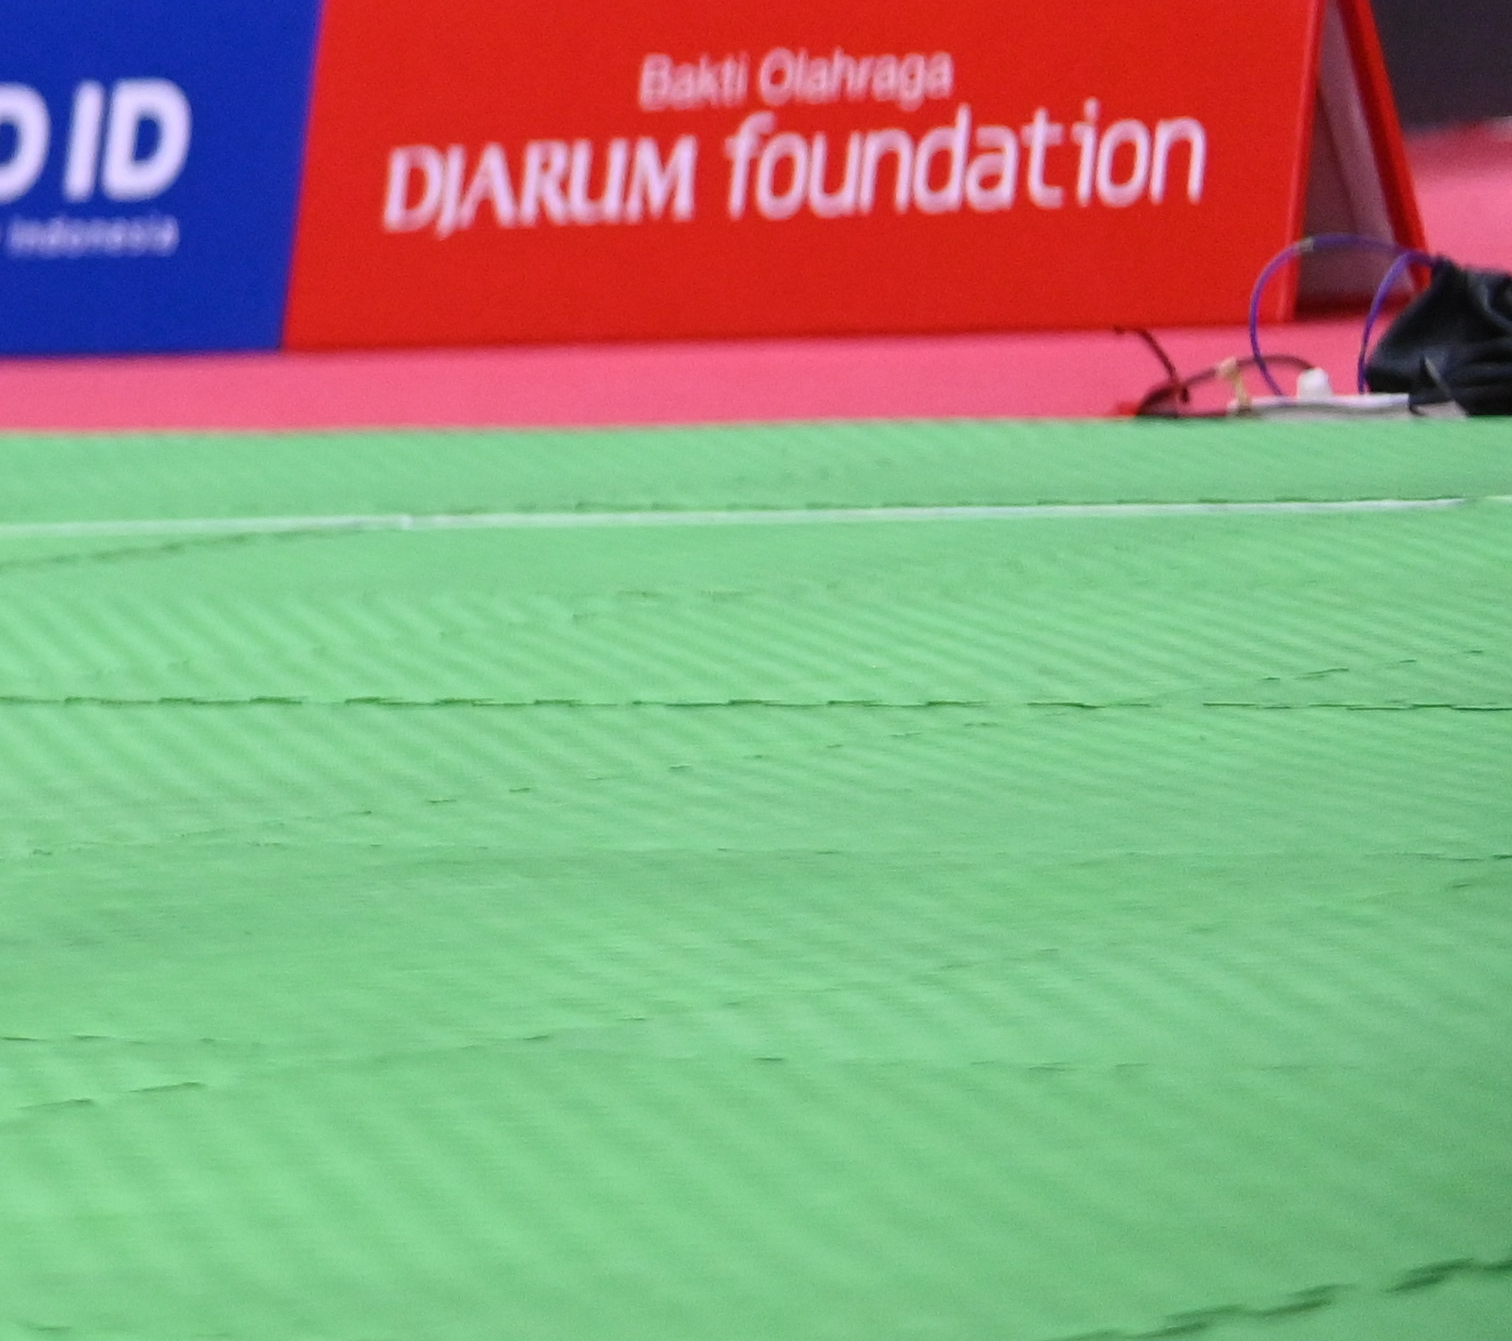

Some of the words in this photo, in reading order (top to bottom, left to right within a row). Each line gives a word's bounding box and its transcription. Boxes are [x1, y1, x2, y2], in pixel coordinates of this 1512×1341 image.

[638, 51, 749, 112] Bakti
[757, 46, 955, 112] Olahraga
[61, 75, 194, 206] ID
[383, 133, 698, 241] DJARUM
[725, 97, 1207, 220] foundation
[6, 212, 180, 259] Indonesia
